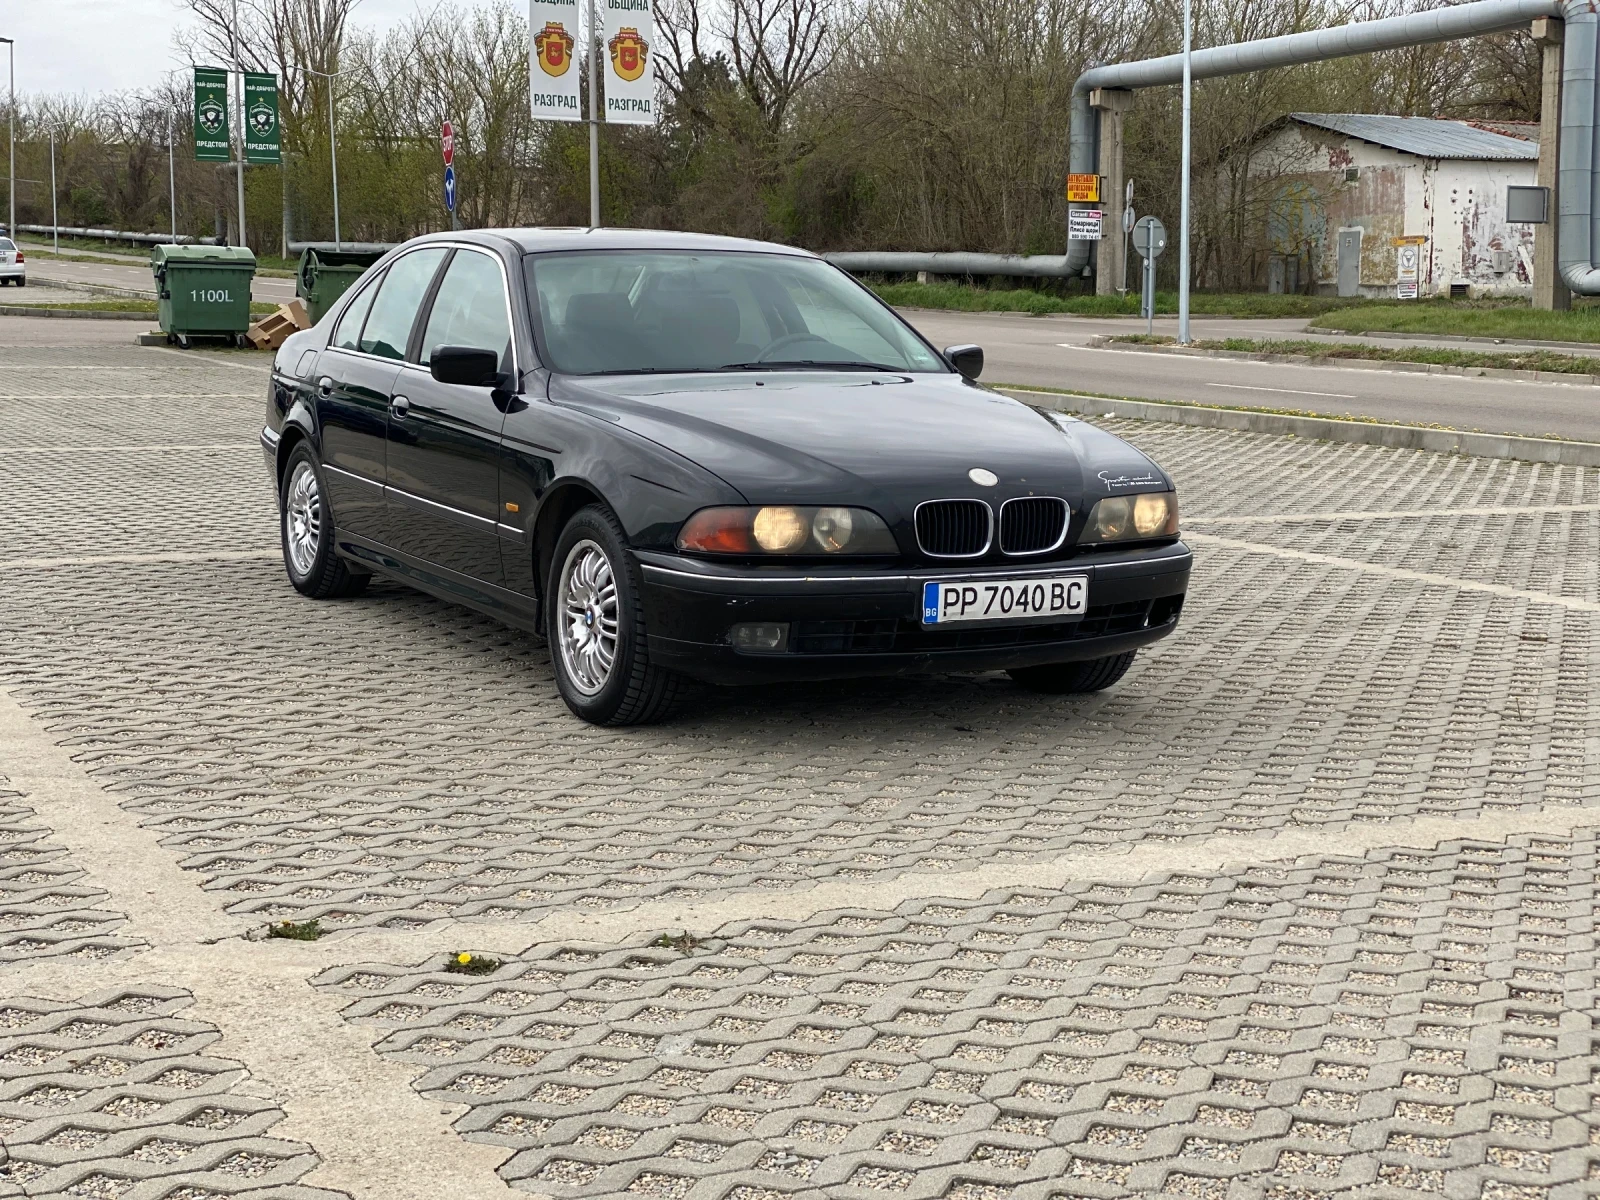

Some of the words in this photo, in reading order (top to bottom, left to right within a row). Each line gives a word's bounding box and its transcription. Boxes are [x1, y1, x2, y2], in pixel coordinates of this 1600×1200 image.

[196, 81, 226, 89] НАЙ-ДОБРОТО
[534, 93, 577, 109] РАЗГРАД
[608, 98, 651, 113] РАЗГРАД
[190, 289, 234, 302] 1100L
[943, 587, 977, 617] PP
[983, 584, 1045, 615] 7040
[1050, 581, 1082, 611] BC
[925, 608, 937, 617] BG
